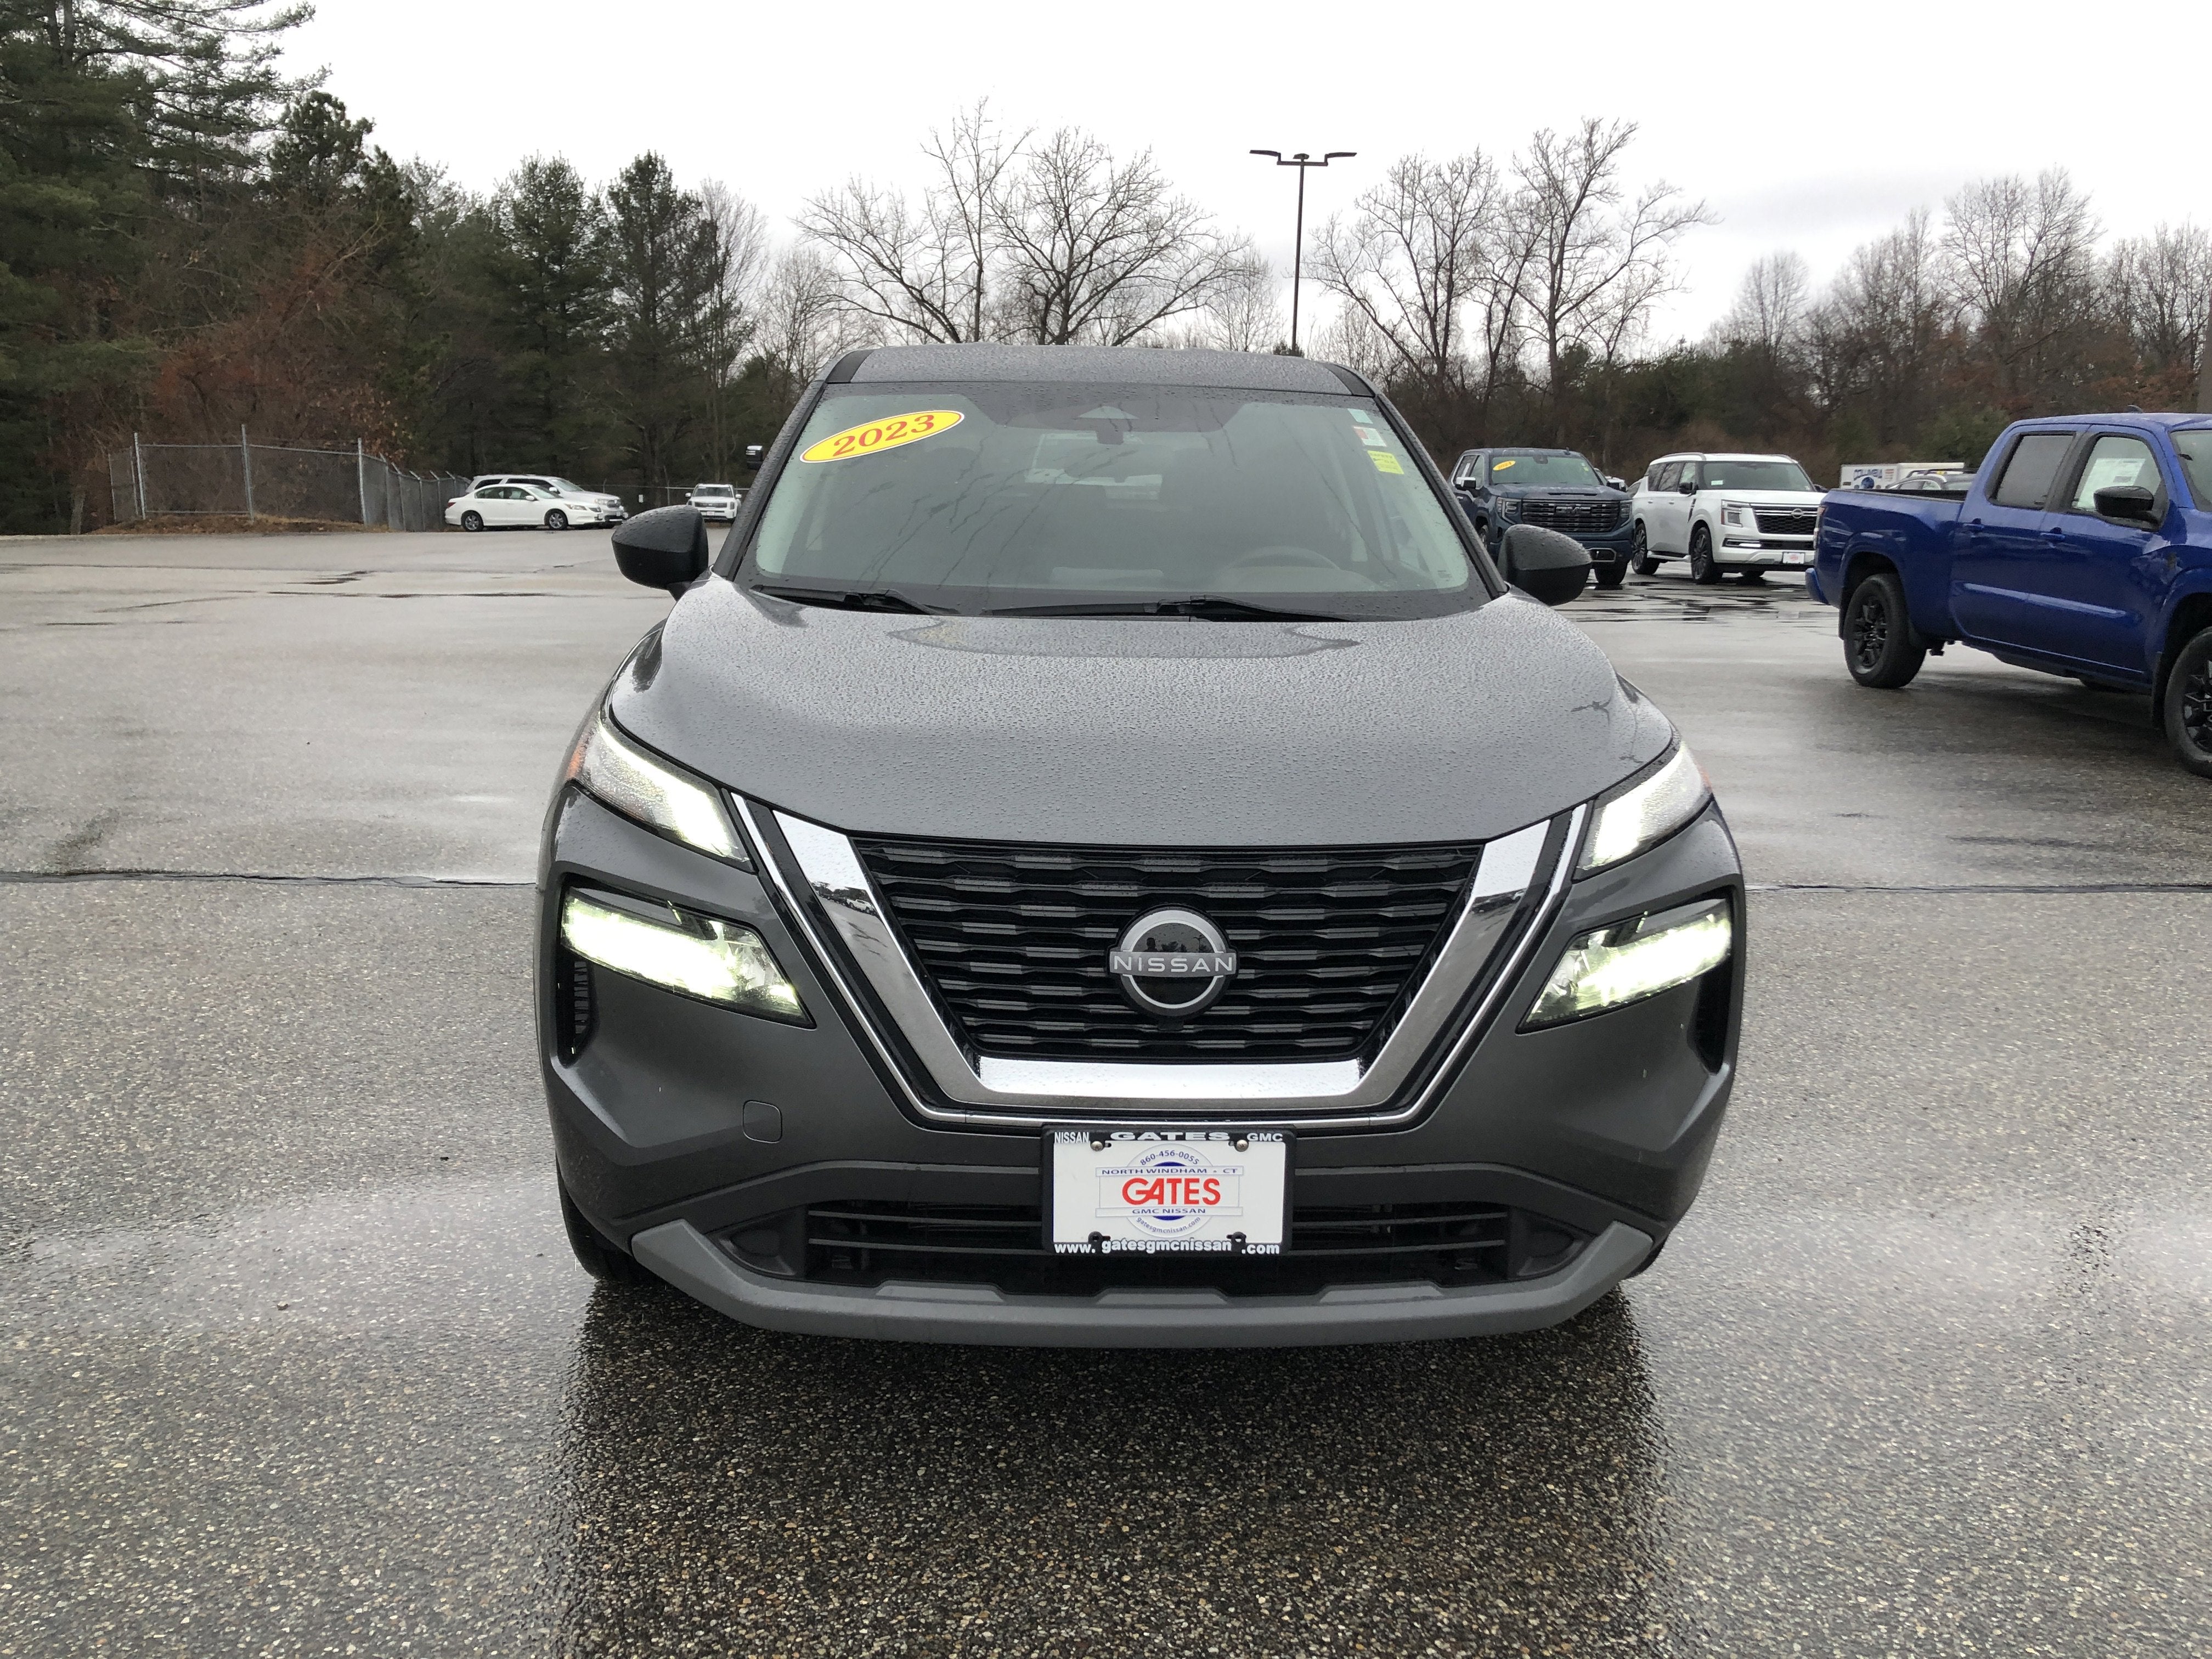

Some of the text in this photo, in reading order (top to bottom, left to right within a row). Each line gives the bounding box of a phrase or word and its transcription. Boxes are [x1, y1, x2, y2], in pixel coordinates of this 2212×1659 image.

[833, 414, 935, 457] 2023
[1114, 955, 1232, 973] NISSAN
[1054, 1131, 1283, 1144] NISSAN GATES GMC
[1140, 1149, 1200, 1166] 860-456-0055
[1121, 1177, 1221, 1205] GATES
[1136, 1216, 1201, 1234] gatesgmcnissan.com
[1054, 1237, 1280, 1255] www. gatesgmcnissan .com
